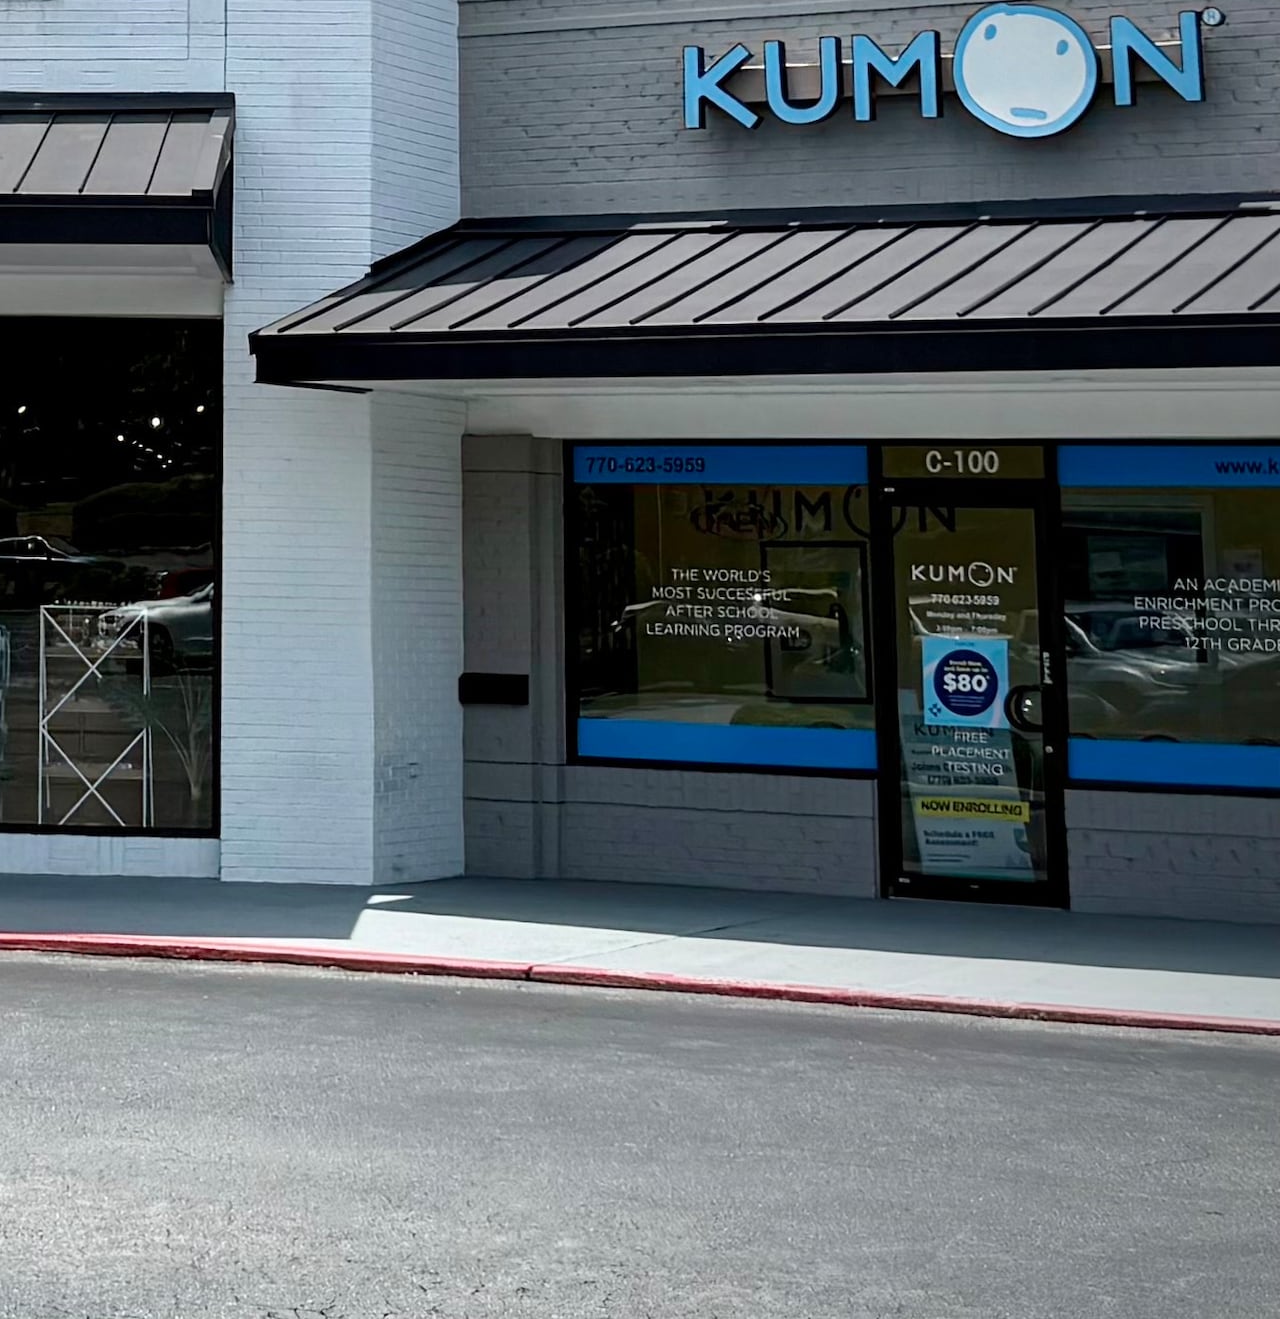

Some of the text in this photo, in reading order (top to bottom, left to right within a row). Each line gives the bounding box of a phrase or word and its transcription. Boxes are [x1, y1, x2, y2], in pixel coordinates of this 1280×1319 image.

[586, 457, 706, 473] 770-623-5959
[925, 450, 999, 473] C-100
[671, 568, 771, 582] THE WORLD'S
[911, 561, 1013, 587] KUMON
[1174, 578, 1198, 590] AN
[652, 586, 693, 599] MOST
[1134, 596, 1243, 611] ENRICHMENT
[665, 604, 779, 620] AFTER SCHOOL
[646, 623, 800, 638] LEARNING PROGRAM
[1139, 616, 1243, 631] PRESCHOOL
[1185, 637, 1221, 649] 12TH
[954, 731, 988, 743] FREE
[931, 745, 1010, 759] PLACEMENT
[944, 761, 1004, 776] TESTING
[921, 800, 1023, 816] NOW ENROLLING
